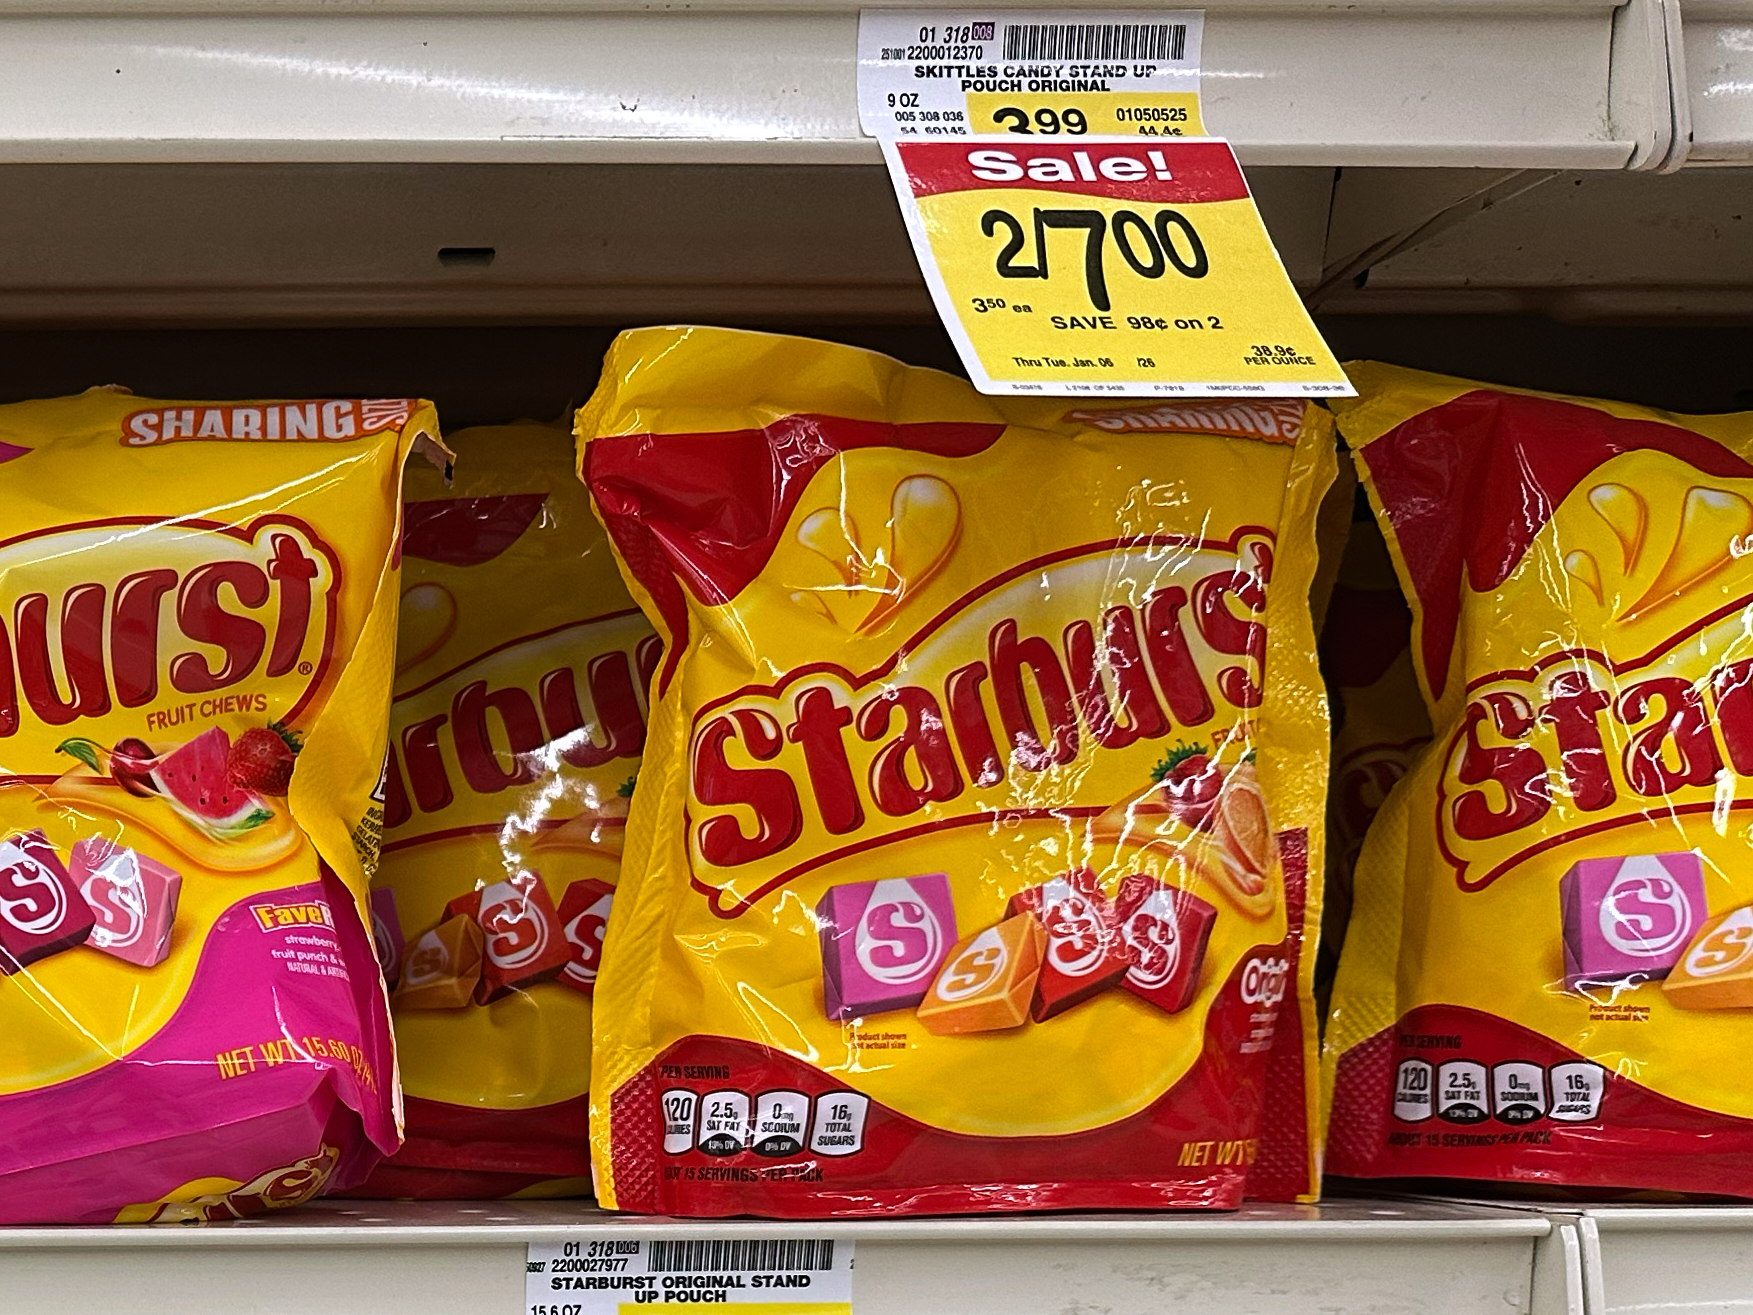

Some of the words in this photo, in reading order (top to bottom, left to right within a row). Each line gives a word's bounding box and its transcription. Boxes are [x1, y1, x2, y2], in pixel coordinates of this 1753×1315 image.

[907, 46, 983, 61] 2200012370
[914, 65, 998, 79] SKITTLES
[1003, 65, 1062, 78] CANDY
[1069, 65, 1127, 78] STAND
[1134, 64, 1156, 78] UP
[961, 80, 1022, 92] POUCH
[1028, 79, 1110, 92] ORIGINAL
[888, 94, 896, 108] 9
[899, 95, 919, 108] OZ
[1116, 108, 1187, 122] 01050525
[967, 150, 1171, 182] Sale!
[1053, 315, 1116, 331] SAVE
[1127, 315, 1167, 332] 98¢
[1174, 318, 1202, 331] on
[1207, 316, 1223, 330] 2
[1244, 357, 1270, 366] PER
[1273, 356, 1315, 366] OUNCE
[361, 400, 410, 430] SIZE
[127, 403, 356, 444] SHARING
[145, 704, 197, 732] FRUIT
[199, 693, 268, 721] CHEWS
[665, 1098, 693, 1122] 120
[551, 1259, 628, 1273] 2200027977
[551, 1277, 656, 1290] STARBURST
[662, 1276, 745, 1288] ORIGINAL
[751, 1275, 810, 1288] STAND
[634, 1290, 659, 1303] UP
[664, 1290, 727, 1303] POUCH
